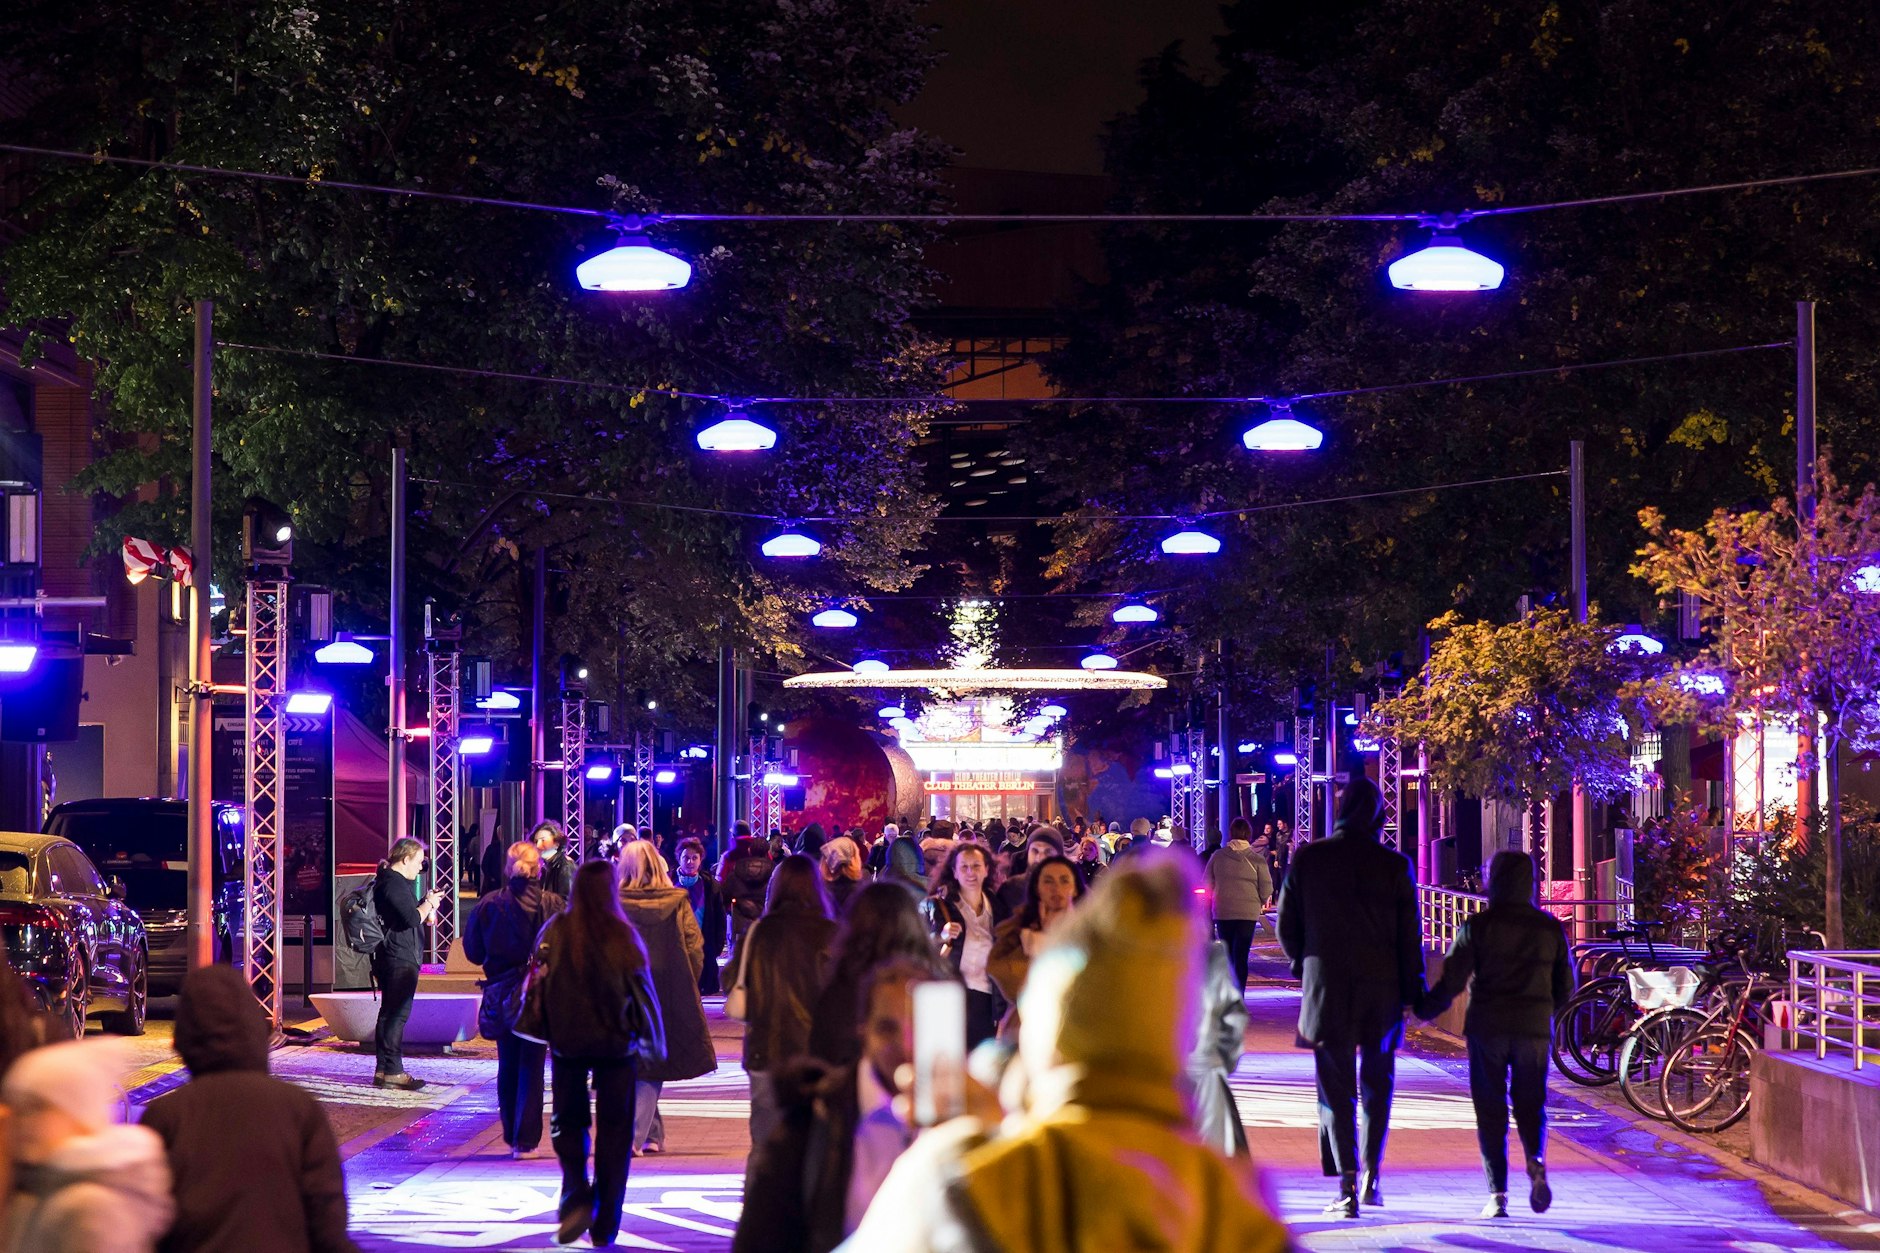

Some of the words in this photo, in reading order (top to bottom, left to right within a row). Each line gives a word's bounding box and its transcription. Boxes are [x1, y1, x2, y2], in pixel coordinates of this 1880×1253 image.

[924, 781, 951, 790] CLUB
[953, 781, 998, 790] THEATER
[998, 781, 1035, 790] BERLIN
